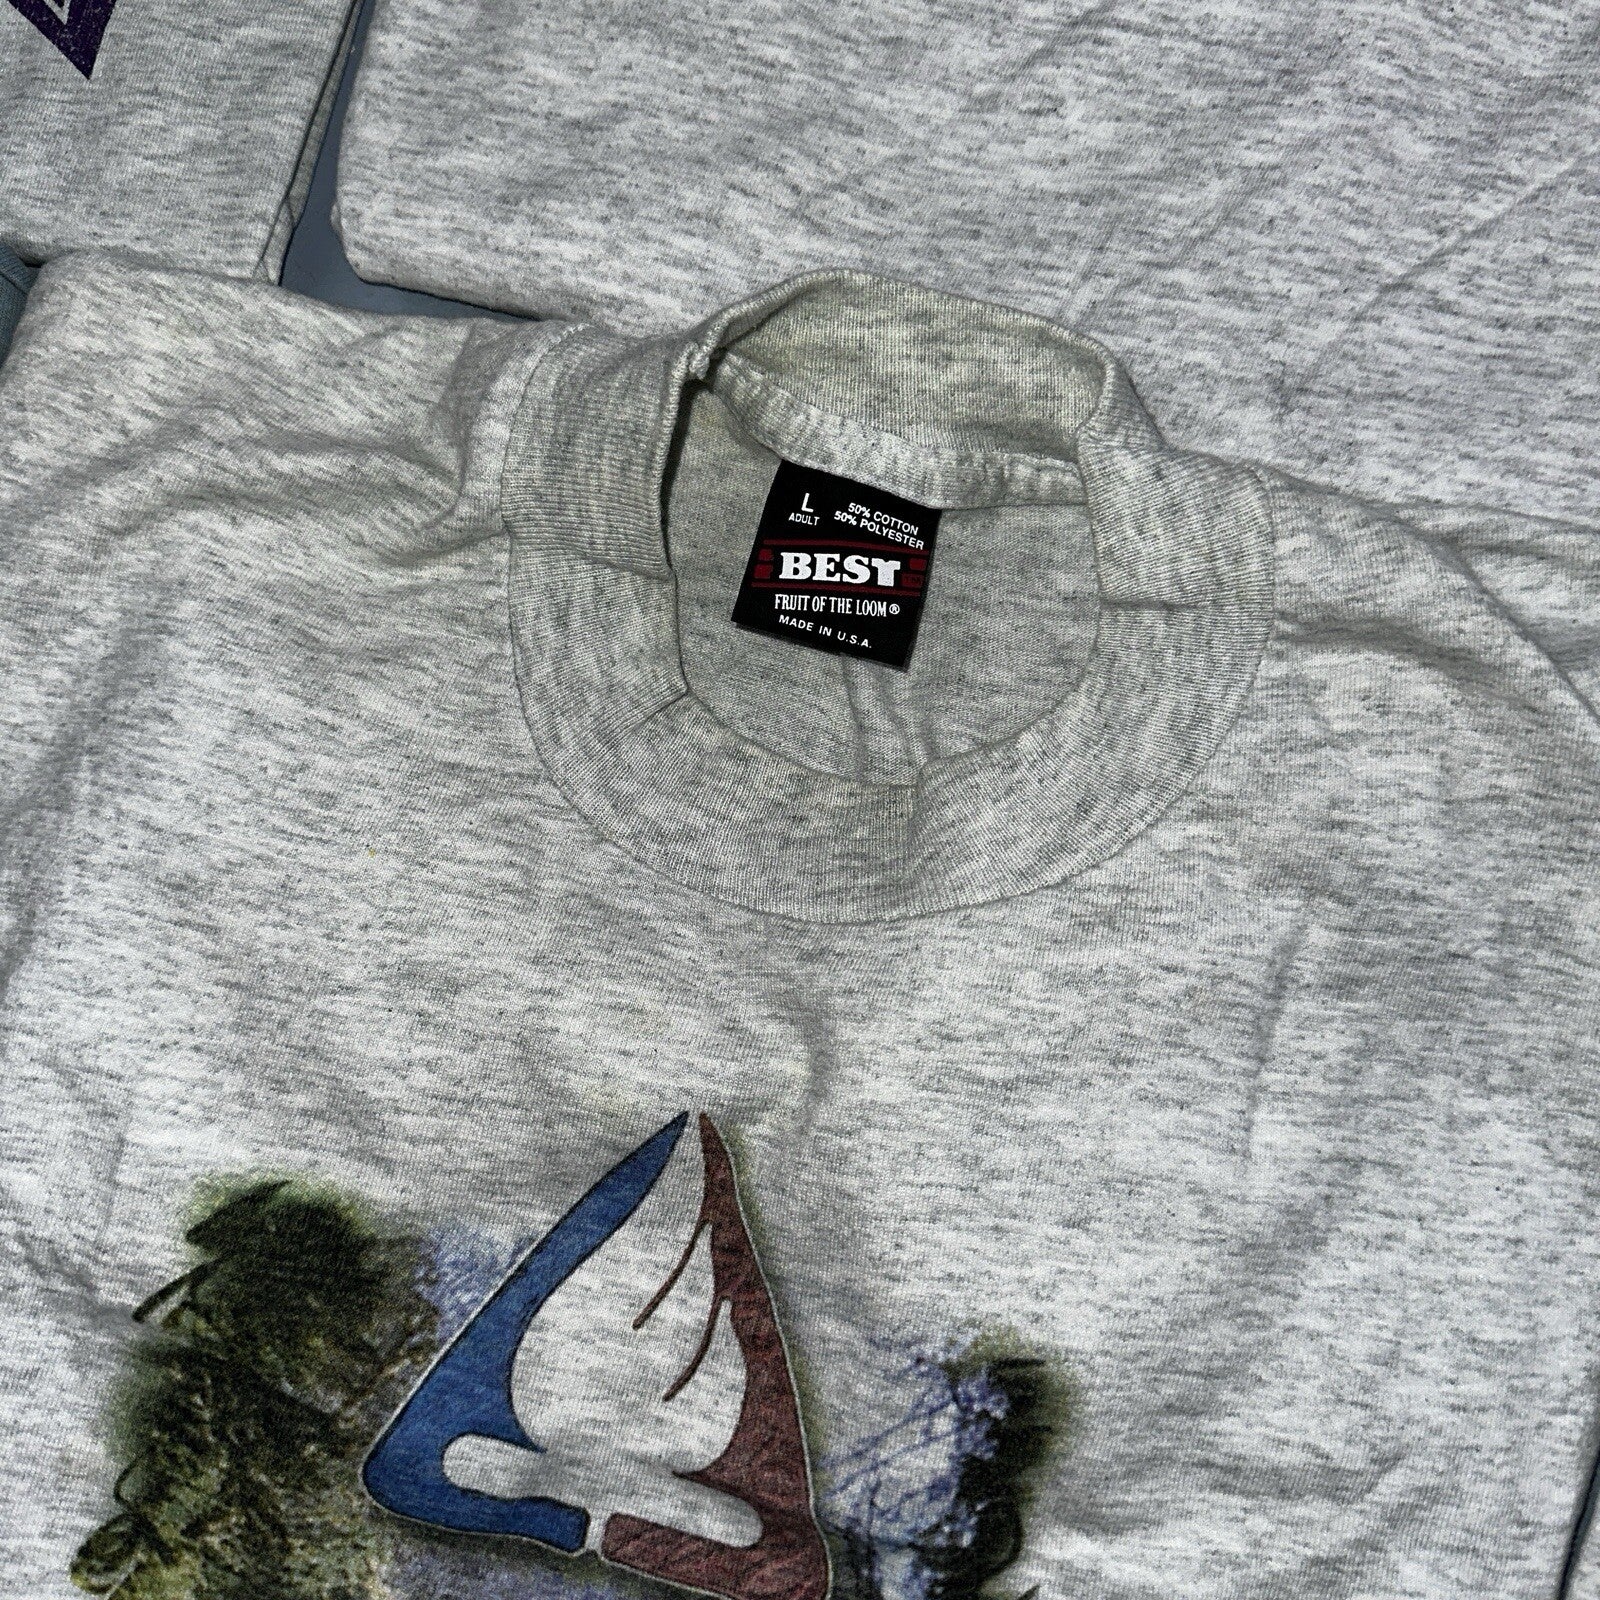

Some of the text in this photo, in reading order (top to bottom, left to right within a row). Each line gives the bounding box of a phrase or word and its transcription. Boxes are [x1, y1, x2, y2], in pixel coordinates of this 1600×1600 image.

[800, 492, 814, 513] L
[788, 512, 820, 526] ADULT
[833, 510, 925, 550] 50% POLYESTER
[847, 502, 919, 536] 50% COTTON
[774, 593, 811, 612] FRUIT
[811, 595, 828, 613] OF
[828, 597, 853, 615] THE
[778, 614, 873, 649] MADE IN U.S.A.
